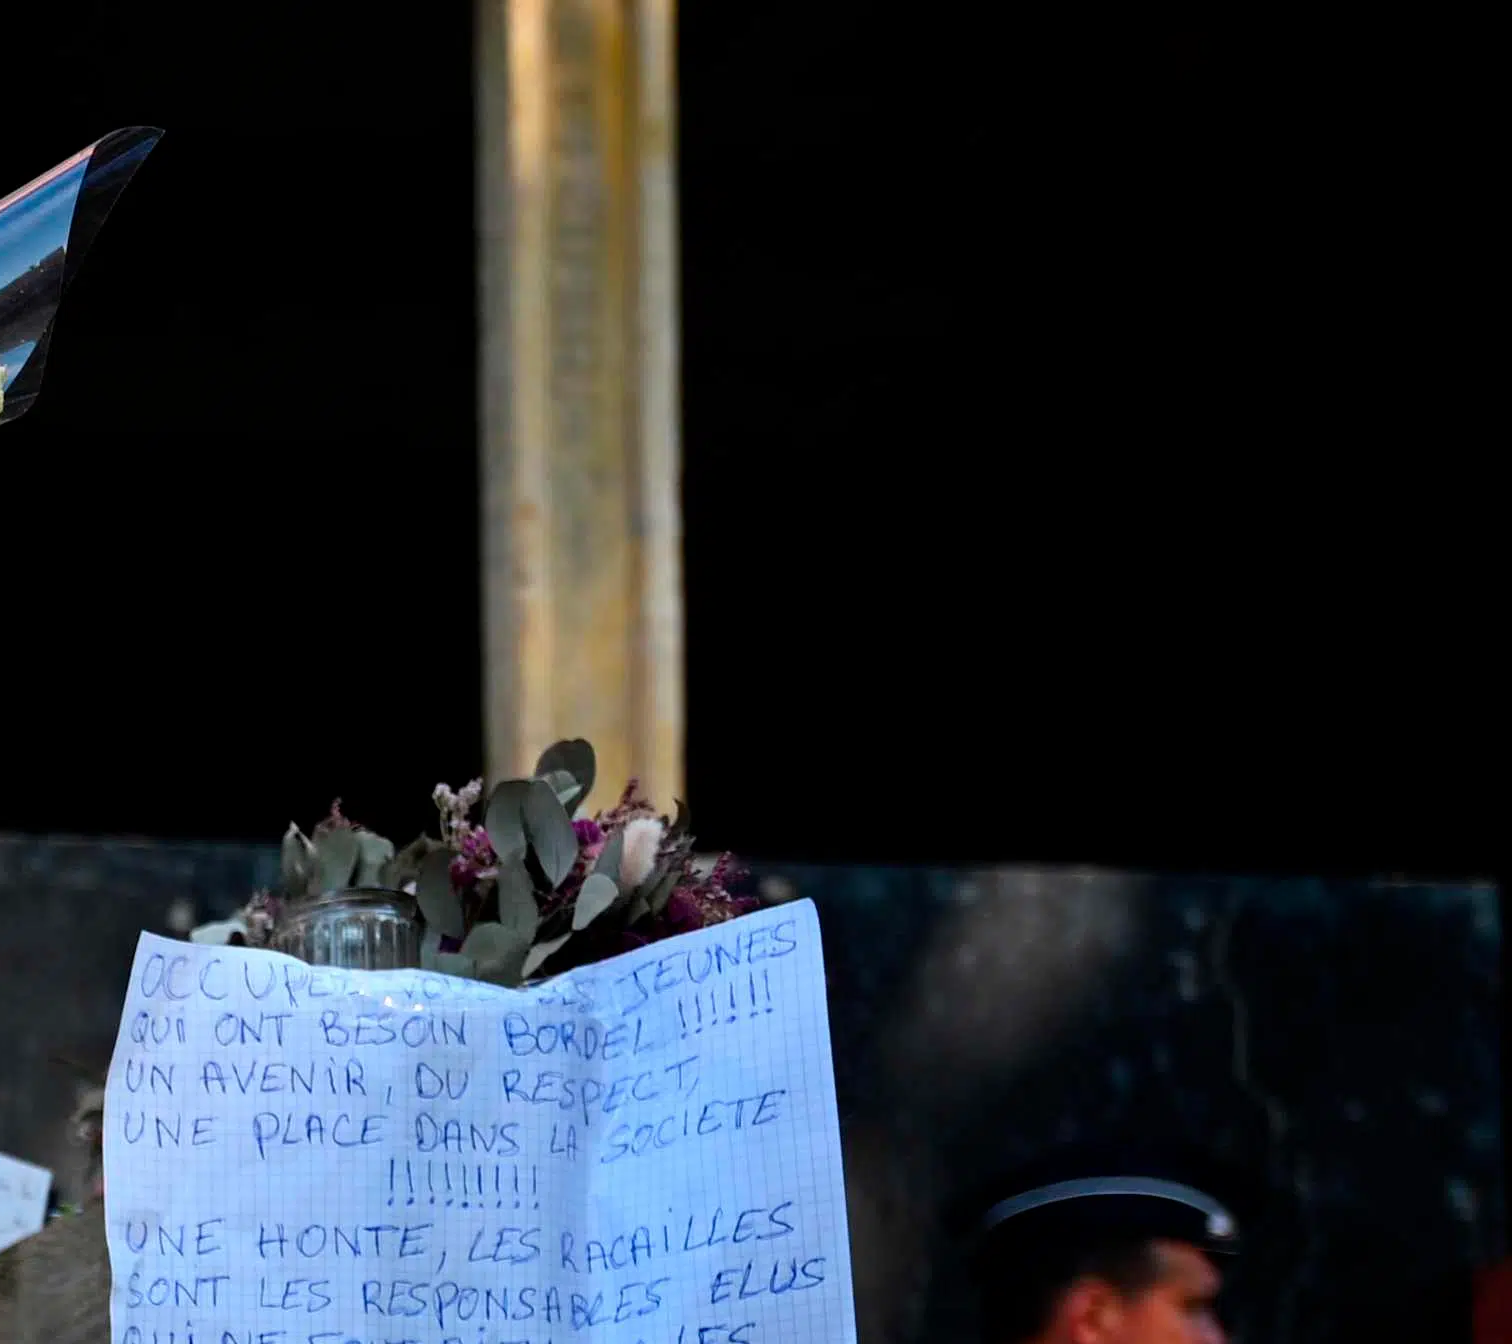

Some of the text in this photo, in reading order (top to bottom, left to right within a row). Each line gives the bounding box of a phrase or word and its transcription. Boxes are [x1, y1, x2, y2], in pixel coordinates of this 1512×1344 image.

[616, 920, 797, 1016] JEUNES
[215, 1013, 295, 1048] ONT
[320, 1010, 467, 1048] BESOIN
[503, 1011, 654, 1061] BORDEL
[125, 1059, 175, 1096] UN
[415, 1062, 469, 1100] DU
[123, 1089, 786, 1164] UNE PLACE DANS LA SOCIETE
[125, 1218, 225, 1257] UNE
[467, 1227, 542, 1266] LES
[127, 1256, 826, 1332] SONT LES RESPONSABLES ELUS
